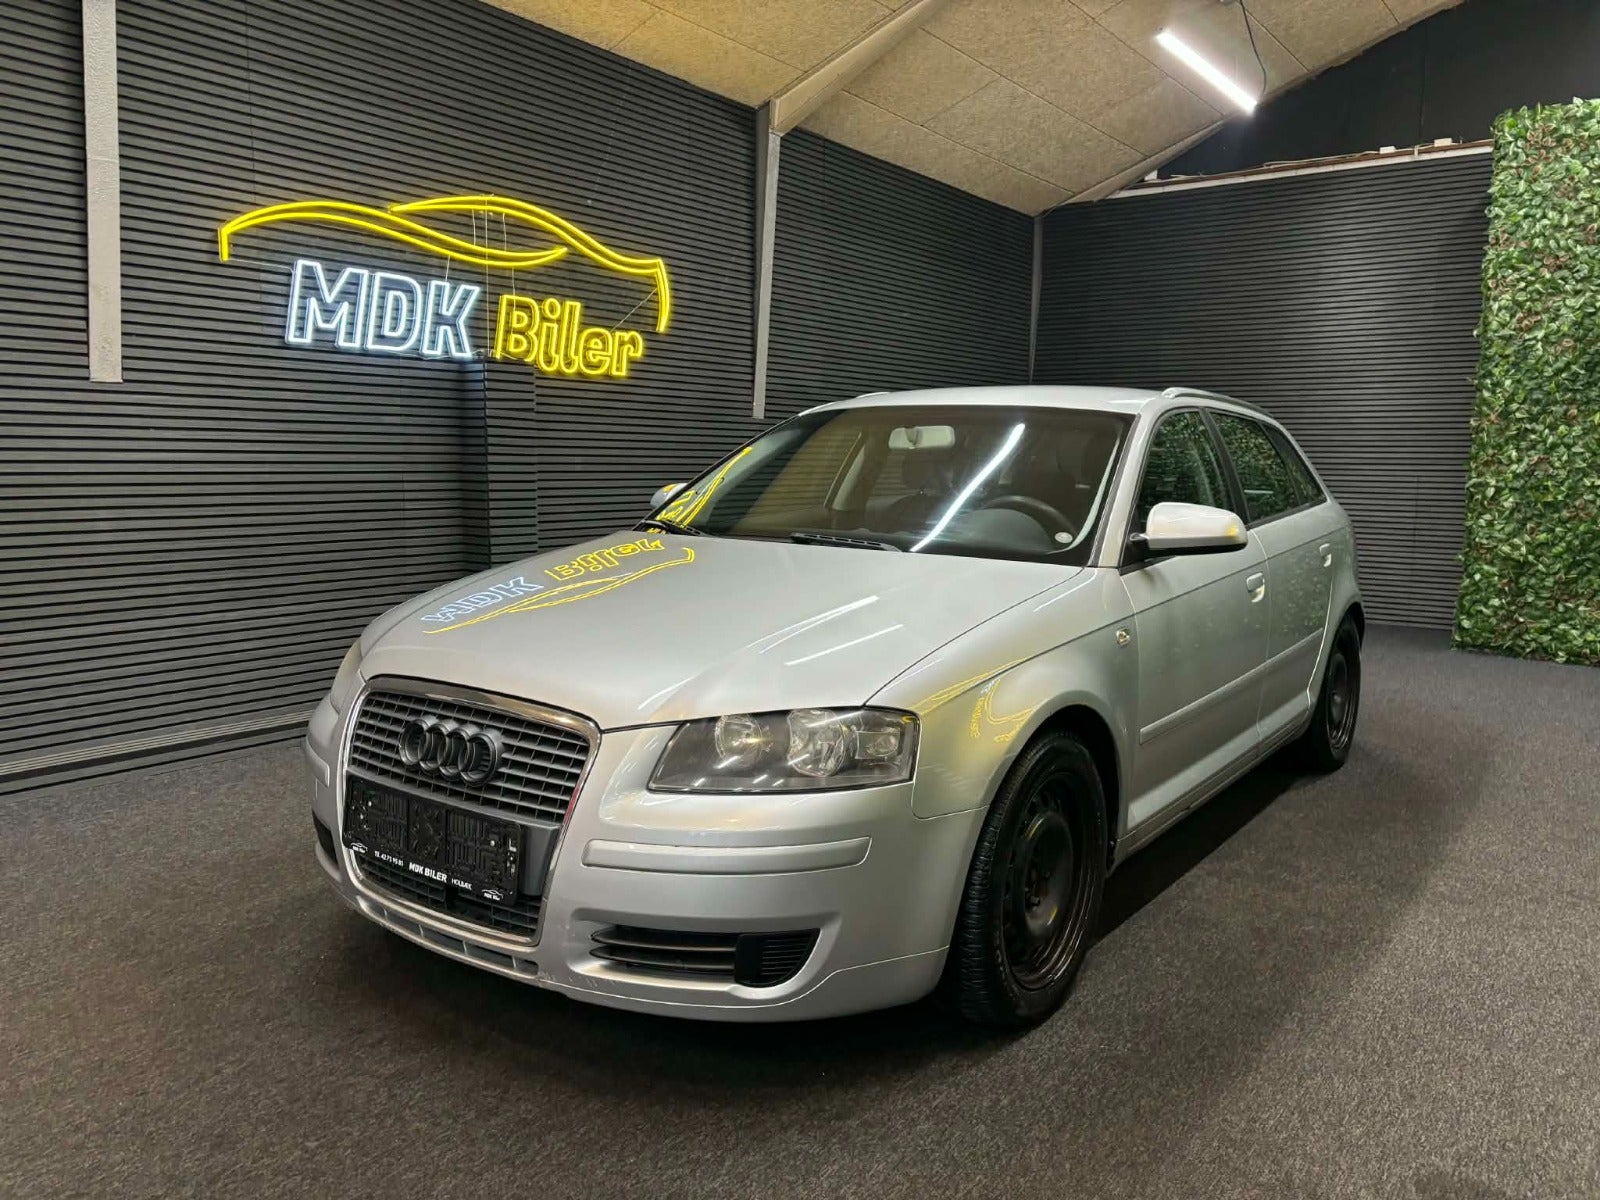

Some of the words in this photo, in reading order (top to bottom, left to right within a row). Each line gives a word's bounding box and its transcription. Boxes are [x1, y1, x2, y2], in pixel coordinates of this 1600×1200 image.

[286, 259, 481, 359] MDK
[494, 294, 642, 376] Biler
[409, 861, 423, 874] MDK
[424, 867, 447, 883] BILER
